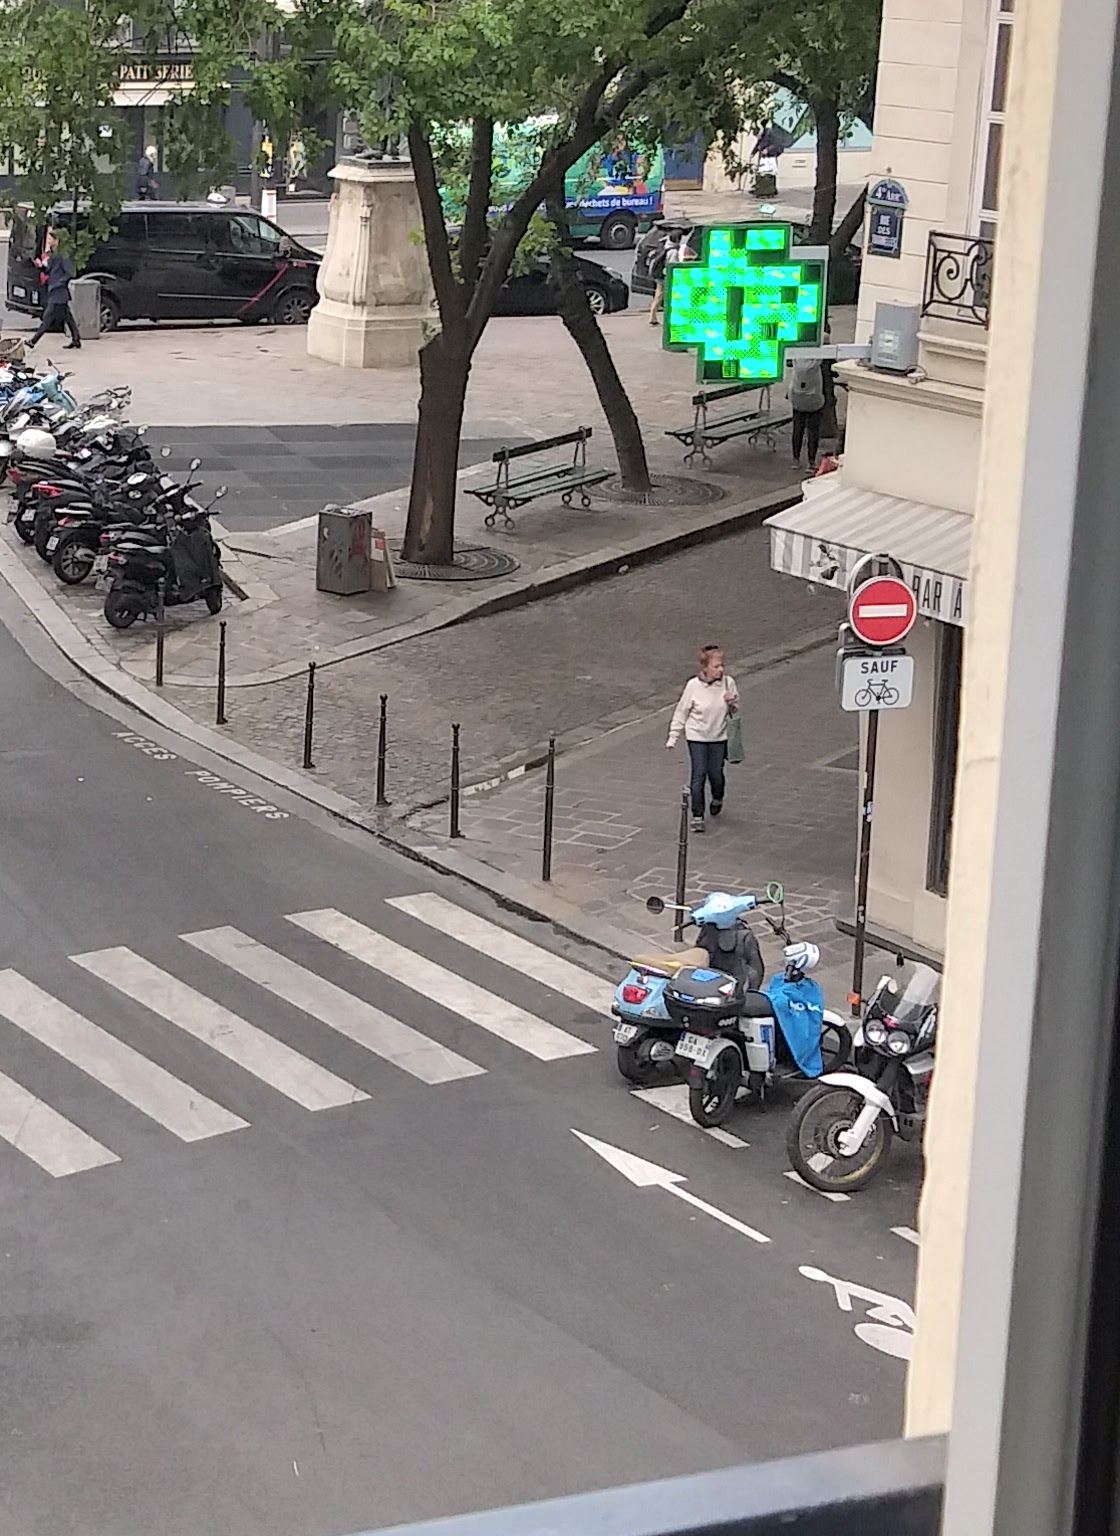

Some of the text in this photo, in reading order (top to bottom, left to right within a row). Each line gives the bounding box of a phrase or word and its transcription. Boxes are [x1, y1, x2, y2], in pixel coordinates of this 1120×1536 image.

[622, 197, 648, 207] bureau
[860, 660, 899, 675] SAUF
[111, 731, 290, 820] ACCES POMPIERS
